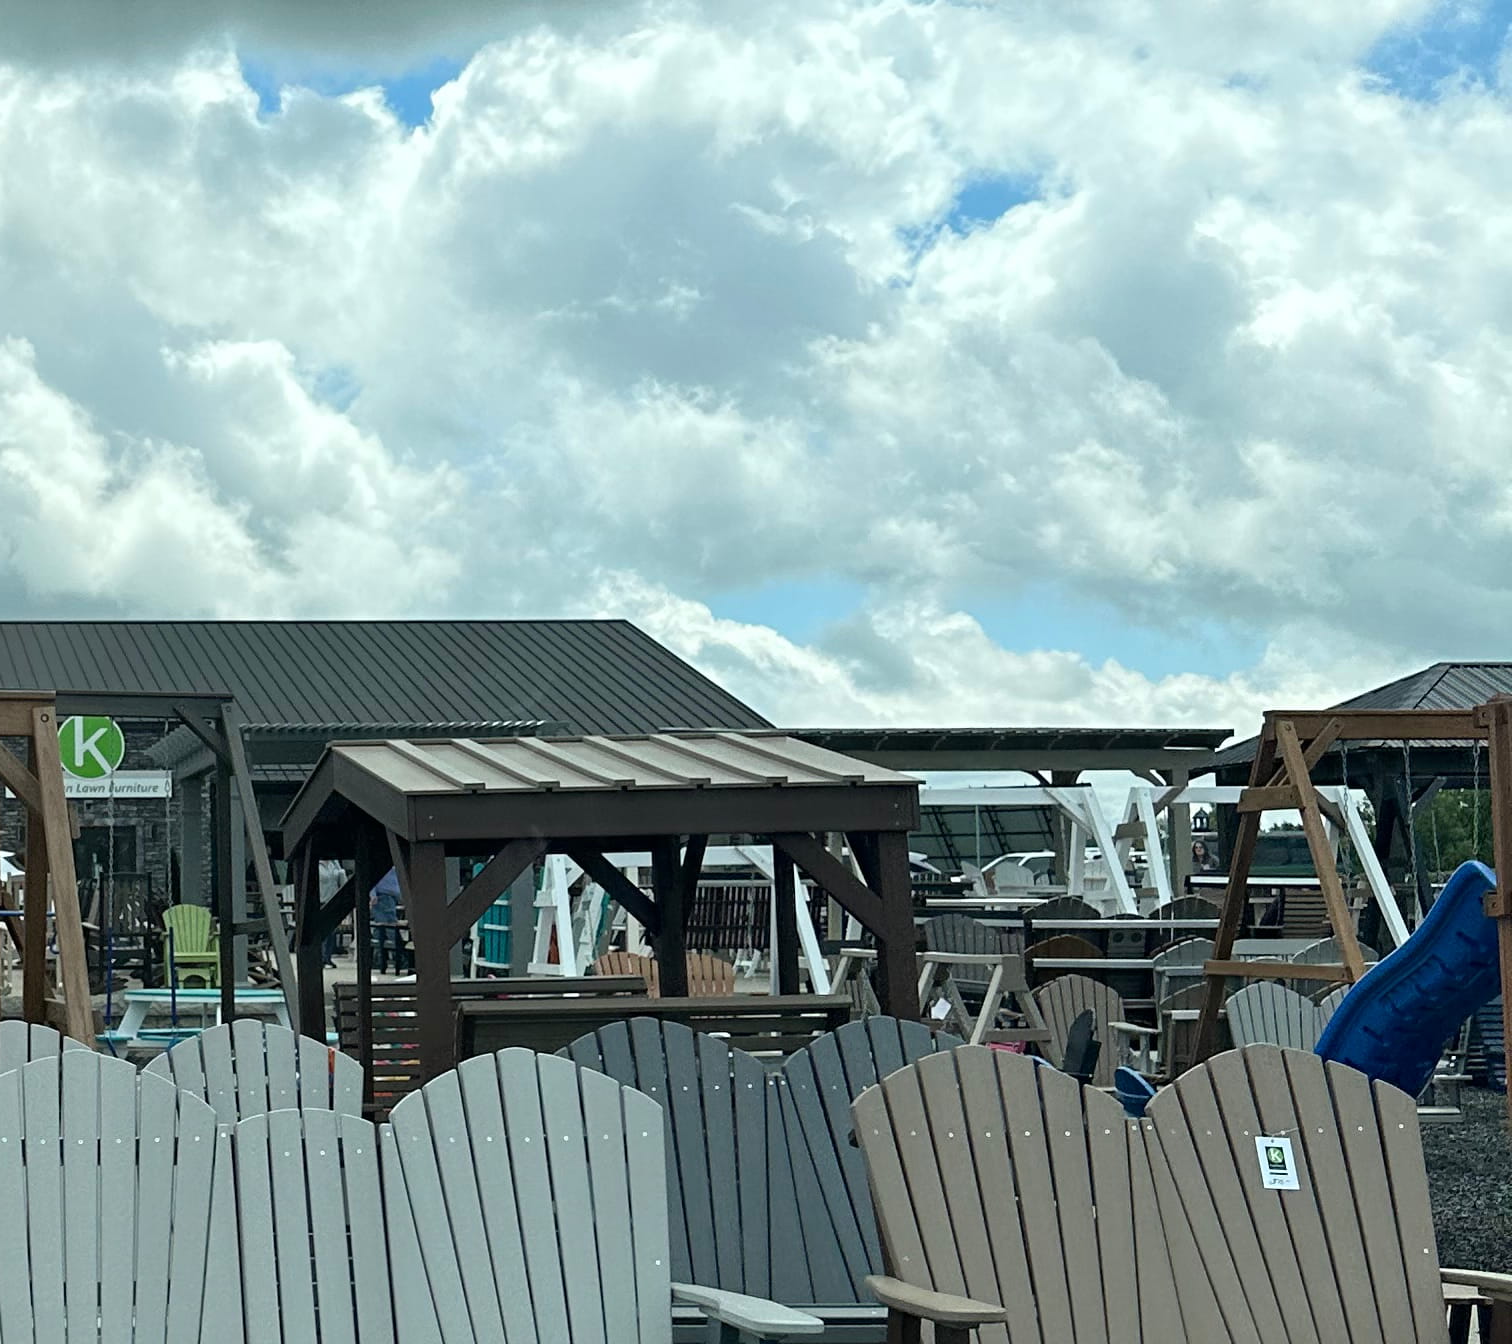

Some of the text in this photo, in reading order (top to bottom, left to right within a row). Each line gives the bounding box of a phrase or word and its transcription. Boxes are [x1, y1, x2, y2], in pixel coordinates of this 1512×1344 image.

[74, 716, 113, 774] K
[76, 783, 106, 793] Lawn
[1270, 1148, 1283, 1163] K
